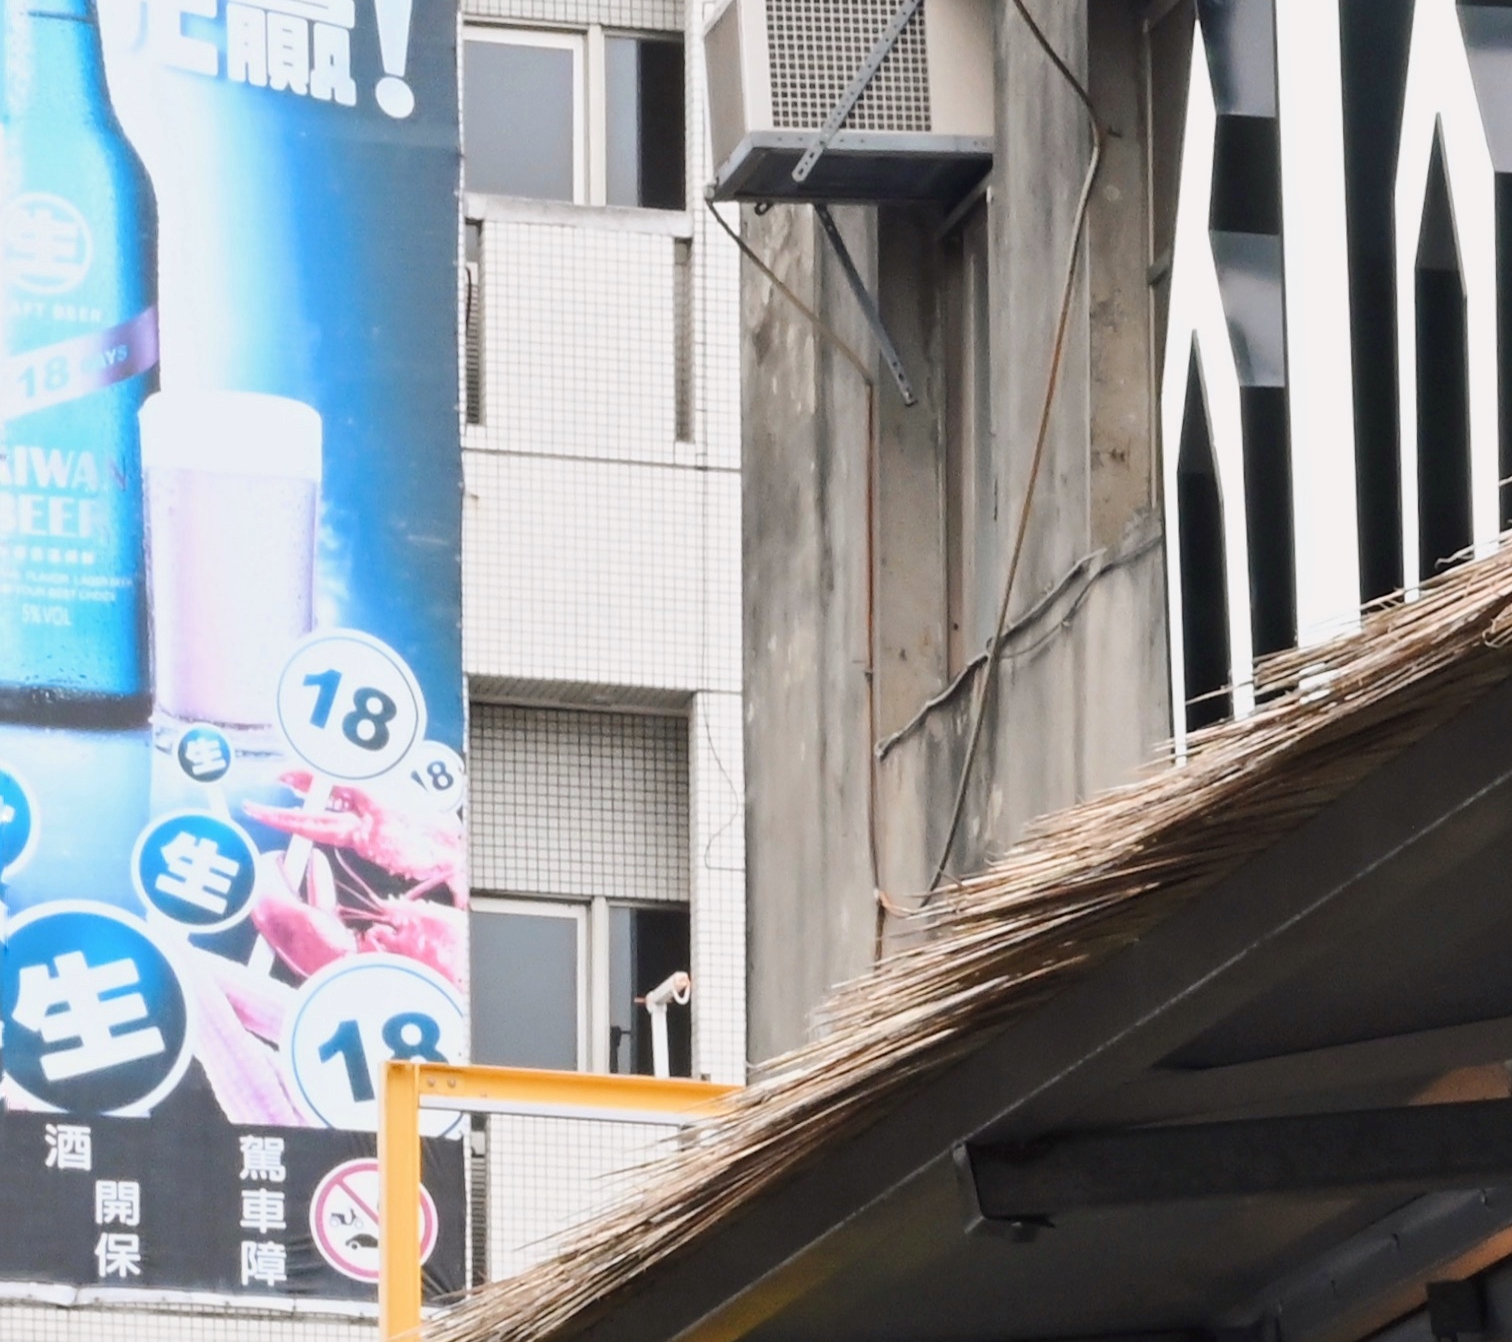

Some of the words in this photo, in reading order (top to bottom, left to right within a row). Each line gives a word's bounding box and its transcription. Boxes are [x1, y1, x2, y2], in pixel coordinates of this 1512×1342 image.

[302, 668, 397, 752] 18
[185, 736, 228, 775] 生
[155, 830, 240, 915] 生
[12, 949, 165, 1081] 生
